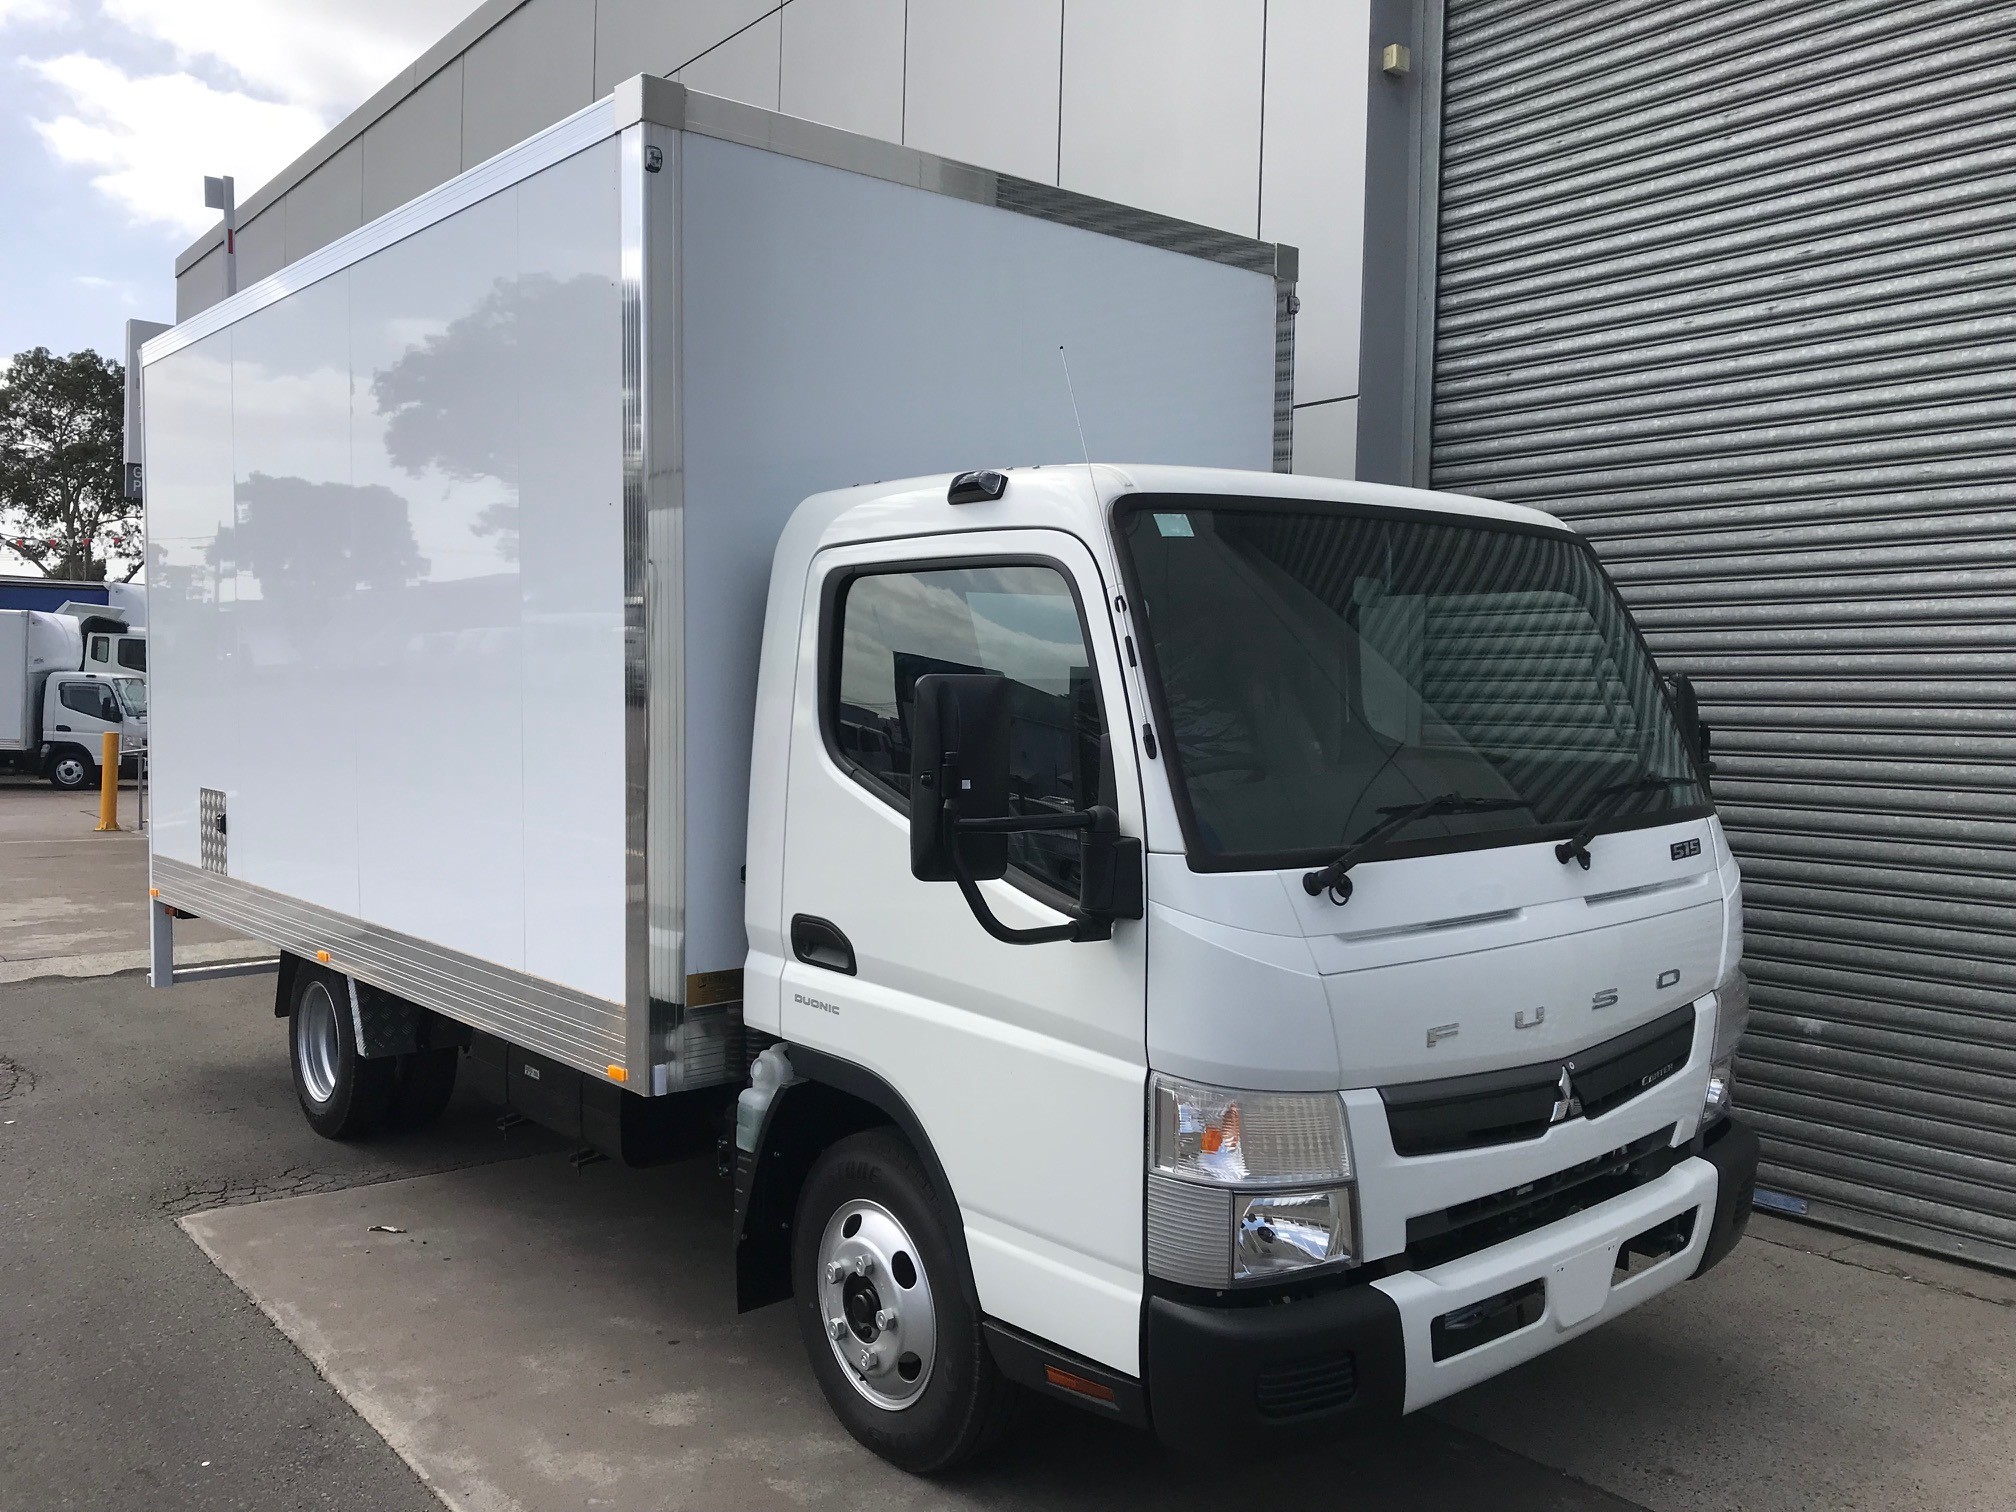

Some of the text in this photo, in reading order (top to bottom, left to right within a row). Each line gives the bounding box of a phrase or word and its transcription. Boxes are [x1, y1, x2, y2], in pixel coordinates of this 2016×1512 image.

[133, 480, 142, 492] P
[1672, 840, 1700, 859] 515
[794, 993, 840, 1016] DUONIC
[1427, 968, 1681, 1048] FUSO
